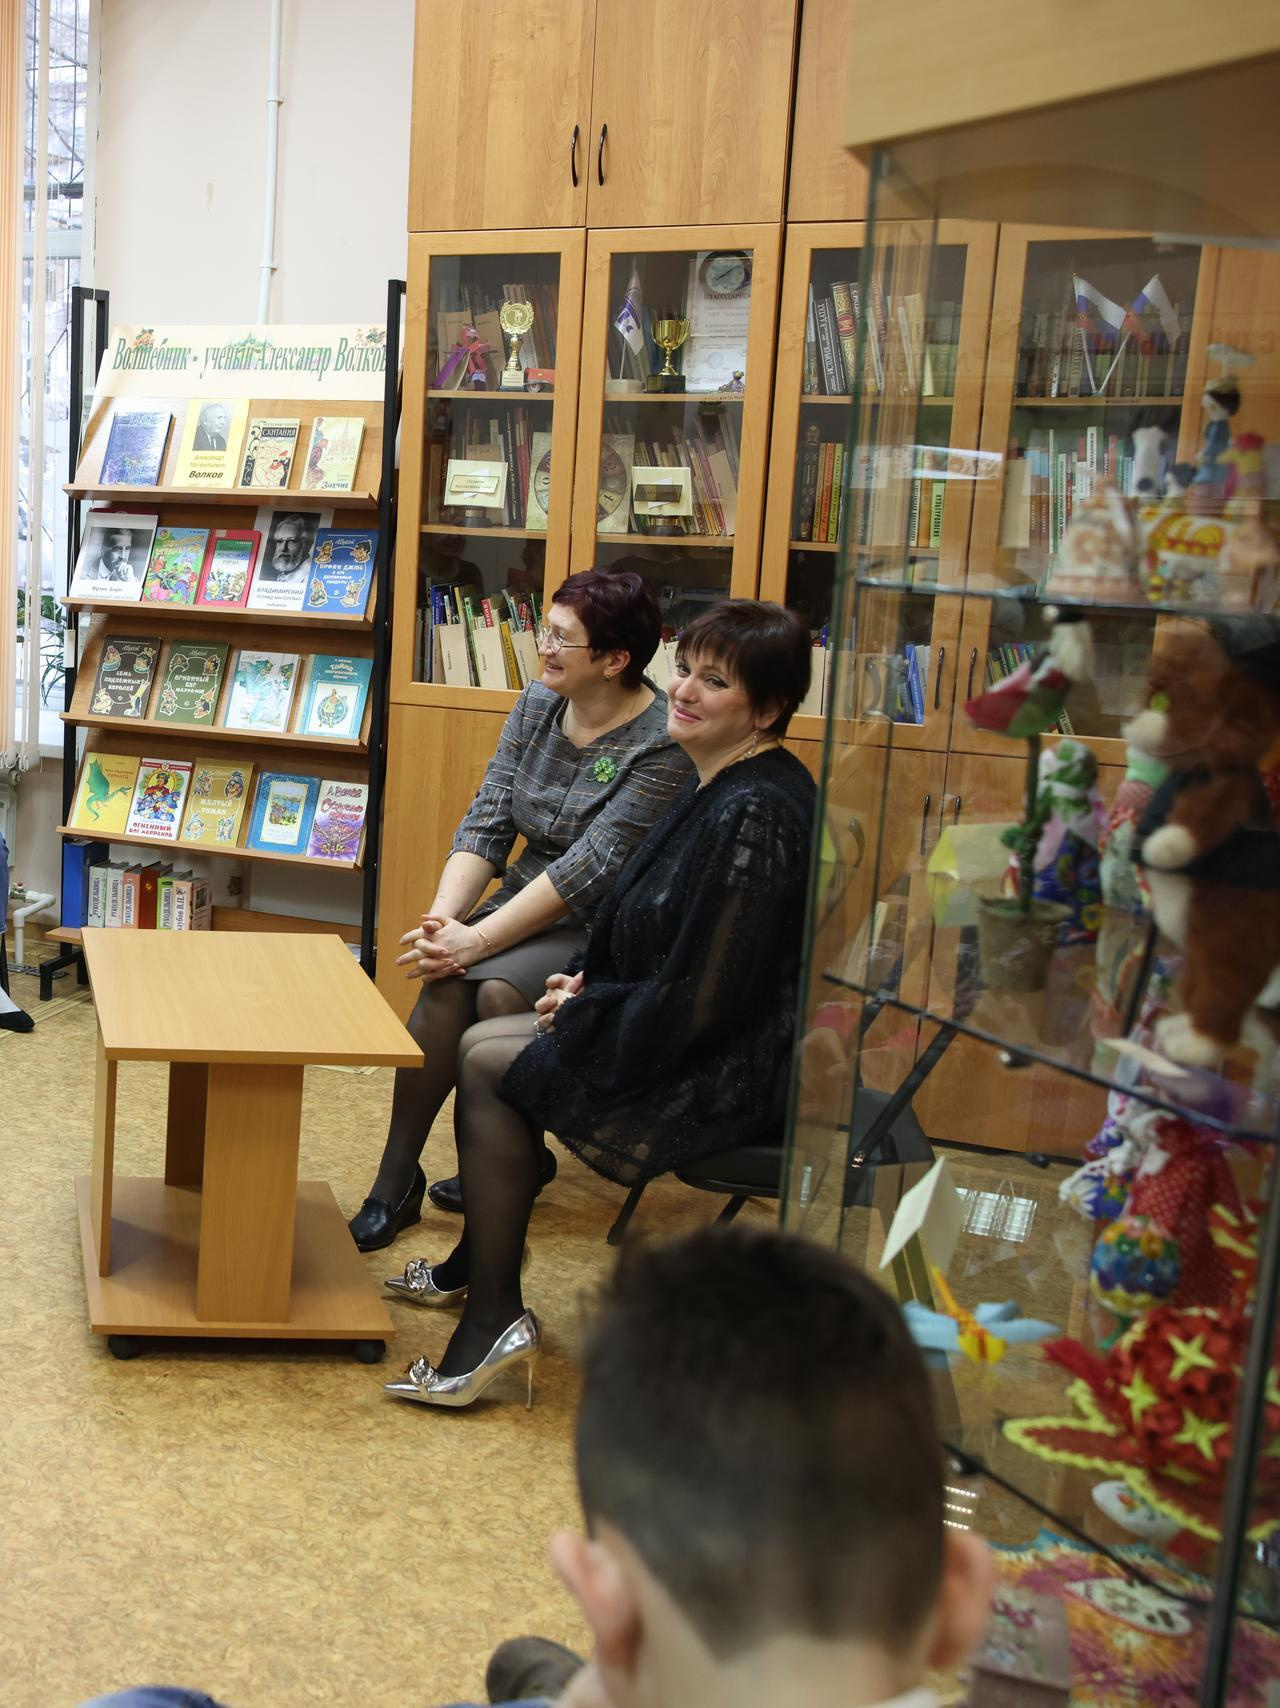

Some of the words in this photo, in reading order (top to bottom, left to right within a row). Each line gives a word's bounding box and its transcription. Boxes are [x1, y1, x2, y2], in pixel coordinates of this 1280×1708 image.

[112, 337, 191, 371] Волшебник
[257, 340, 331, 381] Александр
[333, 337, 387, 372] Волков
[262, 428, 296, 437] СКИТАНИЯ
[189, 470, 224, 478] Волков
[256, 586, 304, 595] ВЛАДИМИРСКИЙ
[133, 822, 172, 831] ОГНЕННЫЙ
